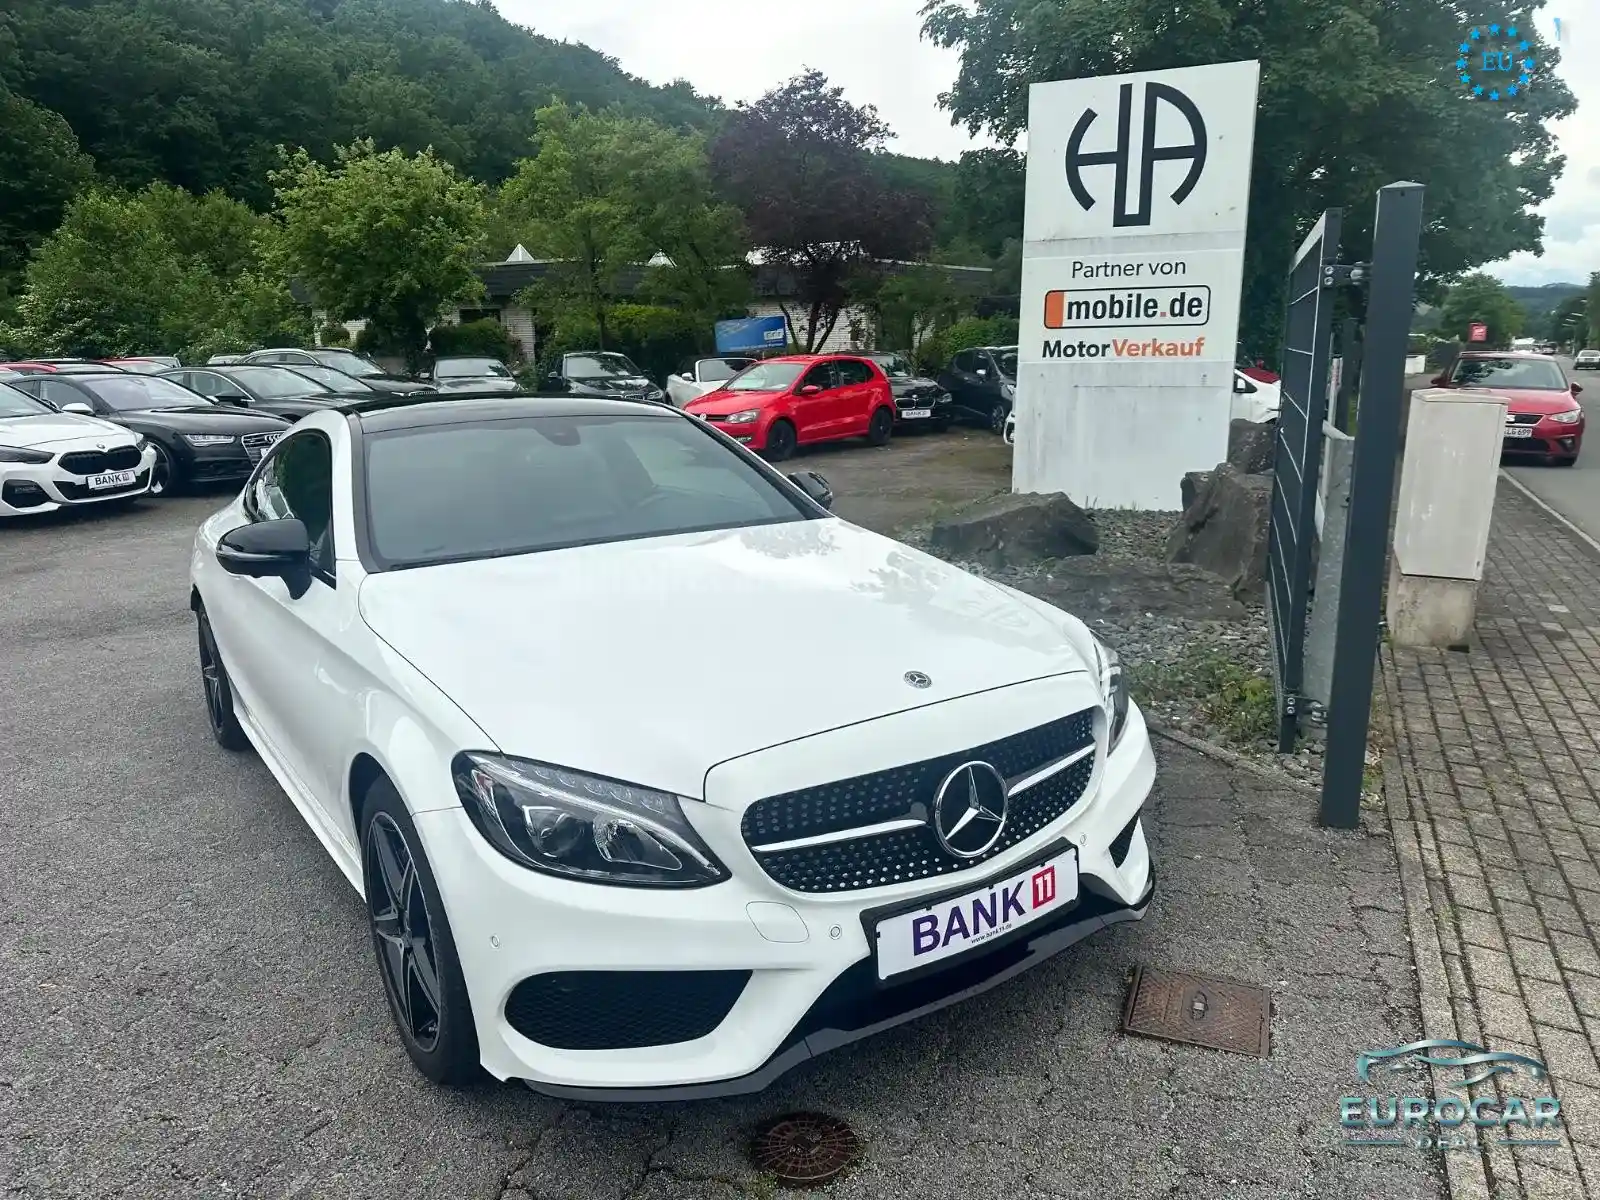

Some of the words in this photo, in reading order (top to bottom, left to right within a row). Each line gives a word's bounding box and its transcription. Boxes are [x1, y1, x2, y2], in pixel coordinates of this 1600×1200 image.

[1072, 261, 1143, 278] Partner
[1149, 261, 1186, 275] von
[1067, 292, 1203, 319] mobile.de
[95, 474, 121, 485] BANK
[912, 880, 1026, 957] BANK
[1033, 867, 1055, 907] 11
